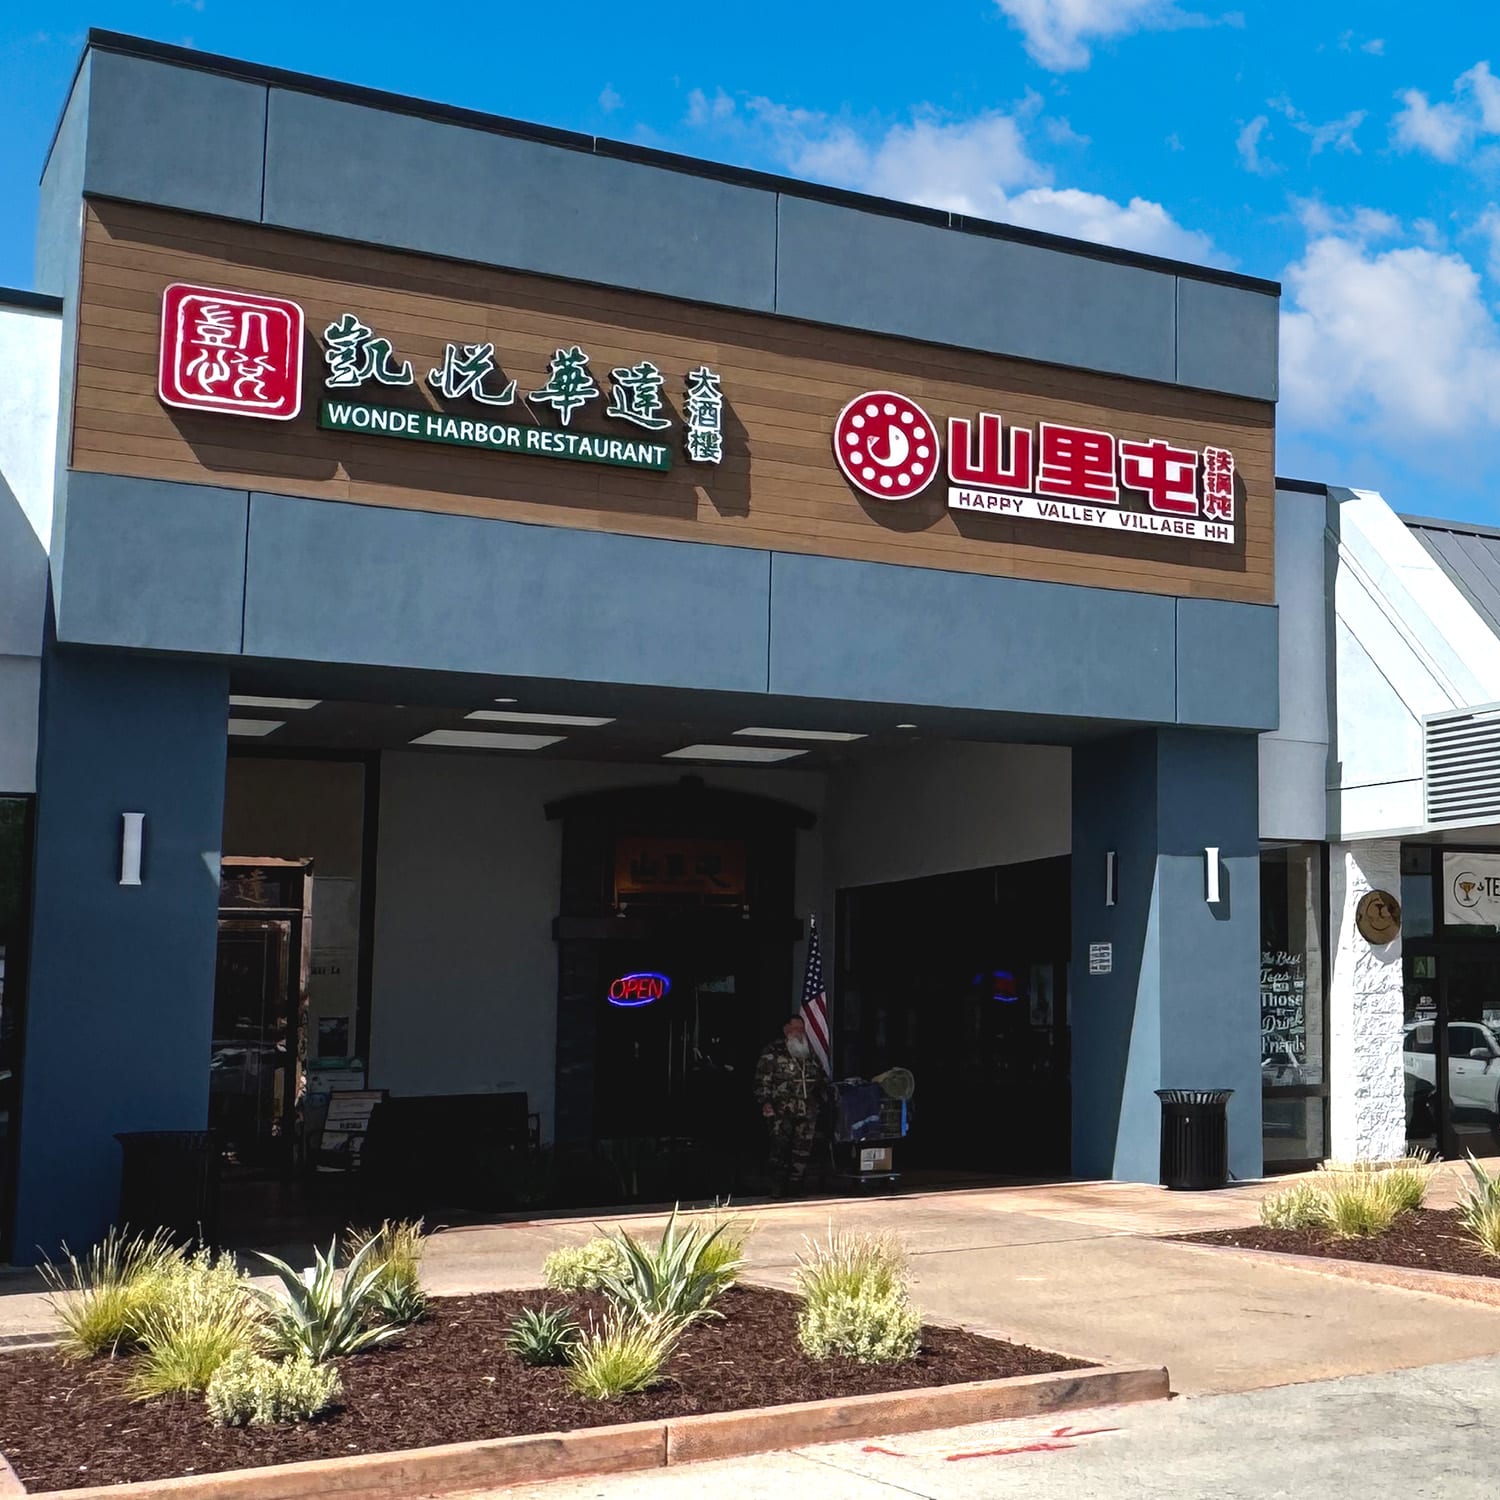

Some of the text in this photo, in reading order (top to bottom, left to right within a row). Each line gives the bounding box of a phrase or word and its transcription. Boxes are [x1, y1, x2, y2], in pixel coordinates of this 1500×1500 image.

[327, 402, 667, 465] WONDE HARBOR RESTAURANT
[949, 412, 1199, 517] 山里屯
[959, 491, 1229, 540] HAPPY VALLEY VILLAGE HH
[610, 978, 663, 1000] OPEN
[1262, 992, 1304, 1007] Those
